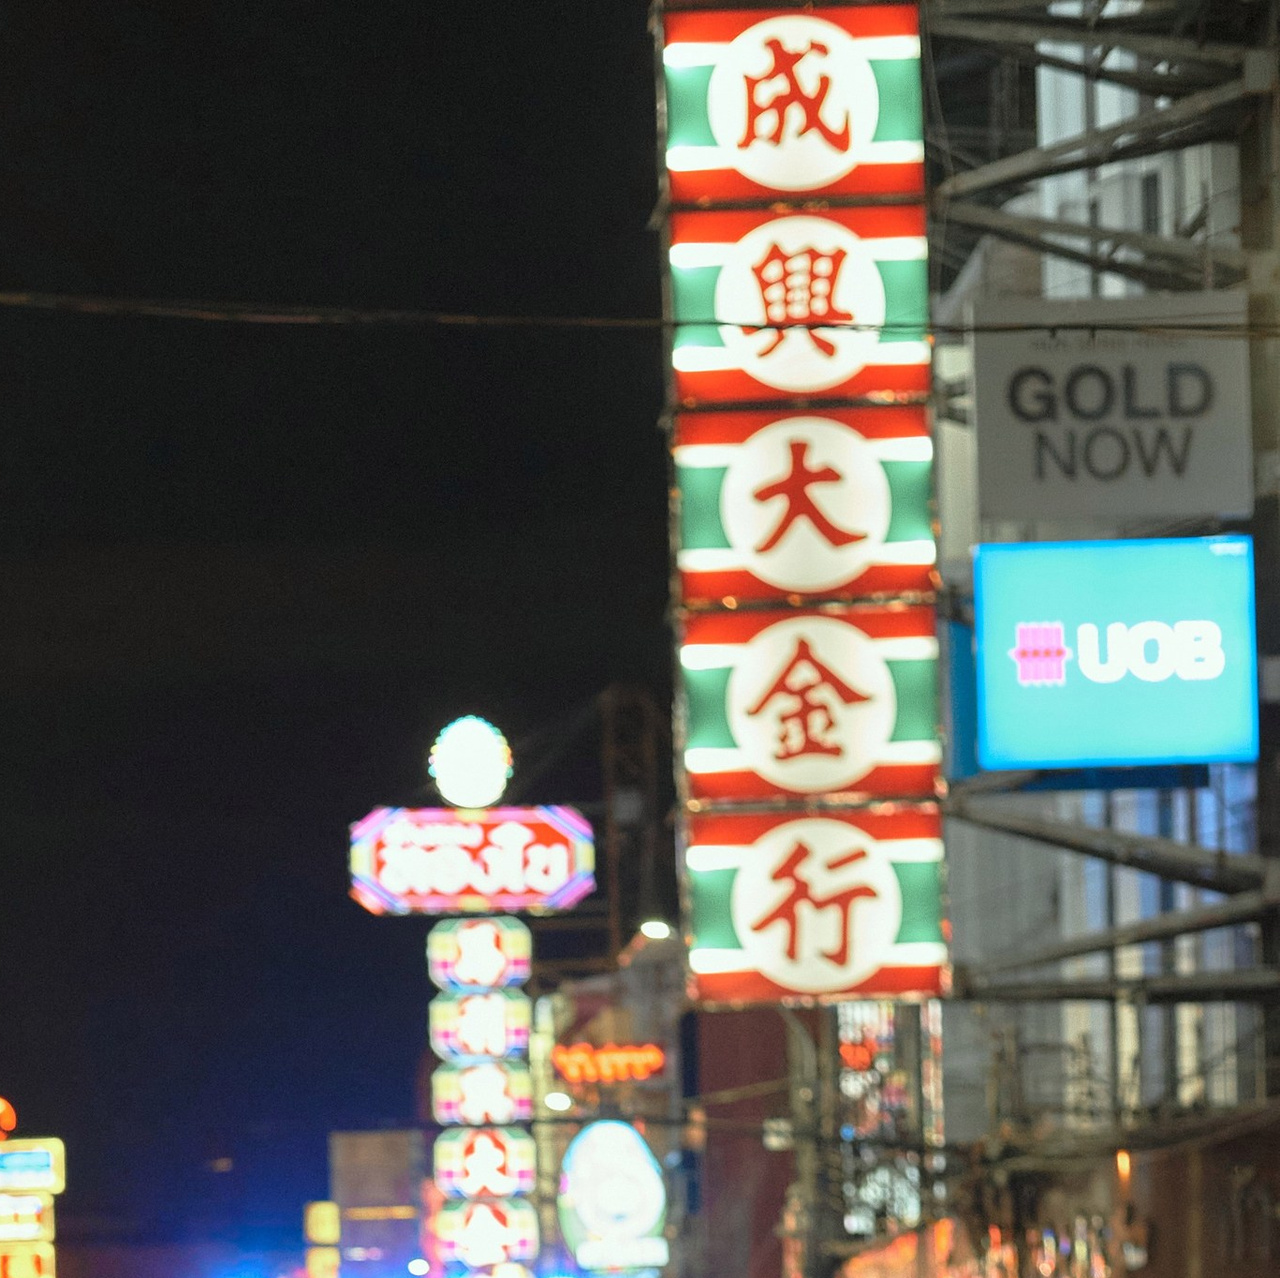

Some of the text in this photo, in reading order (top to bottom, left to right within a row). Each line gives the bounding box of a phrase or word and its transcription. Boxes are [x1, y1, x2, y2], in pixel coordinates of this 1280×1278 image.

[1006, 362, 1215, 424] GOLD
[1034, 427, 1194, 481] NOW
[736, 38, 878, 970] 成興大金行
[1076, 619, 1226, 684] UOB
